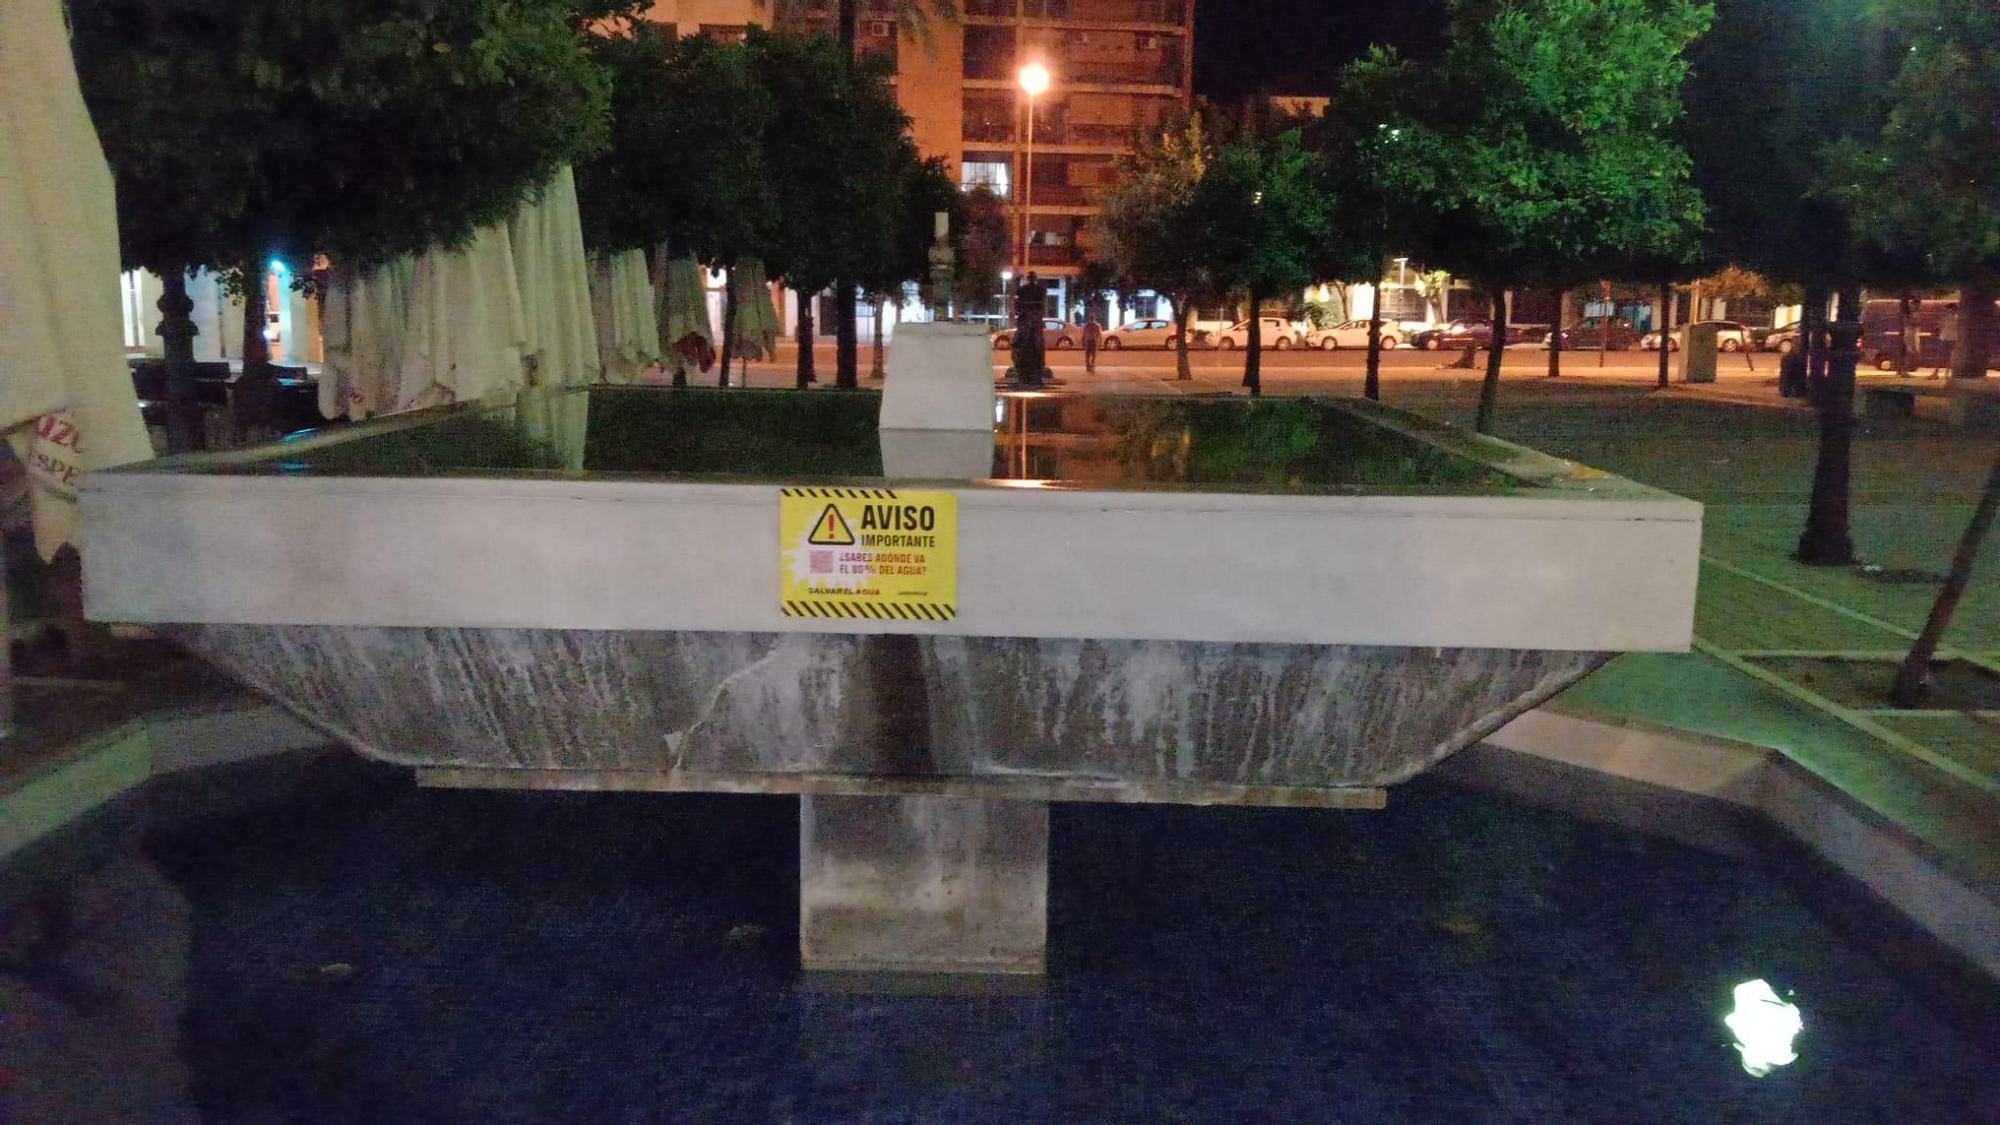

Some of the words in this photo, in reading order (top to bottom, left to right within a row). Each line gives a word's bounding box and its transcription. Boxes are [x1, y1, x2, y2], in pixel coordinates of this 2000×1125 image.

[861, 505, 935, 531] AVISO
[861, 534, 935, 548] IMPORTANTE
[839, 552, 872, 562] ¿SABES
[914, 554, 925, 563] VA
[839, 565, 849, 574] EL
[879, 566, 895, 575] DEL
[897, 566, 927, 575] AGUA?
